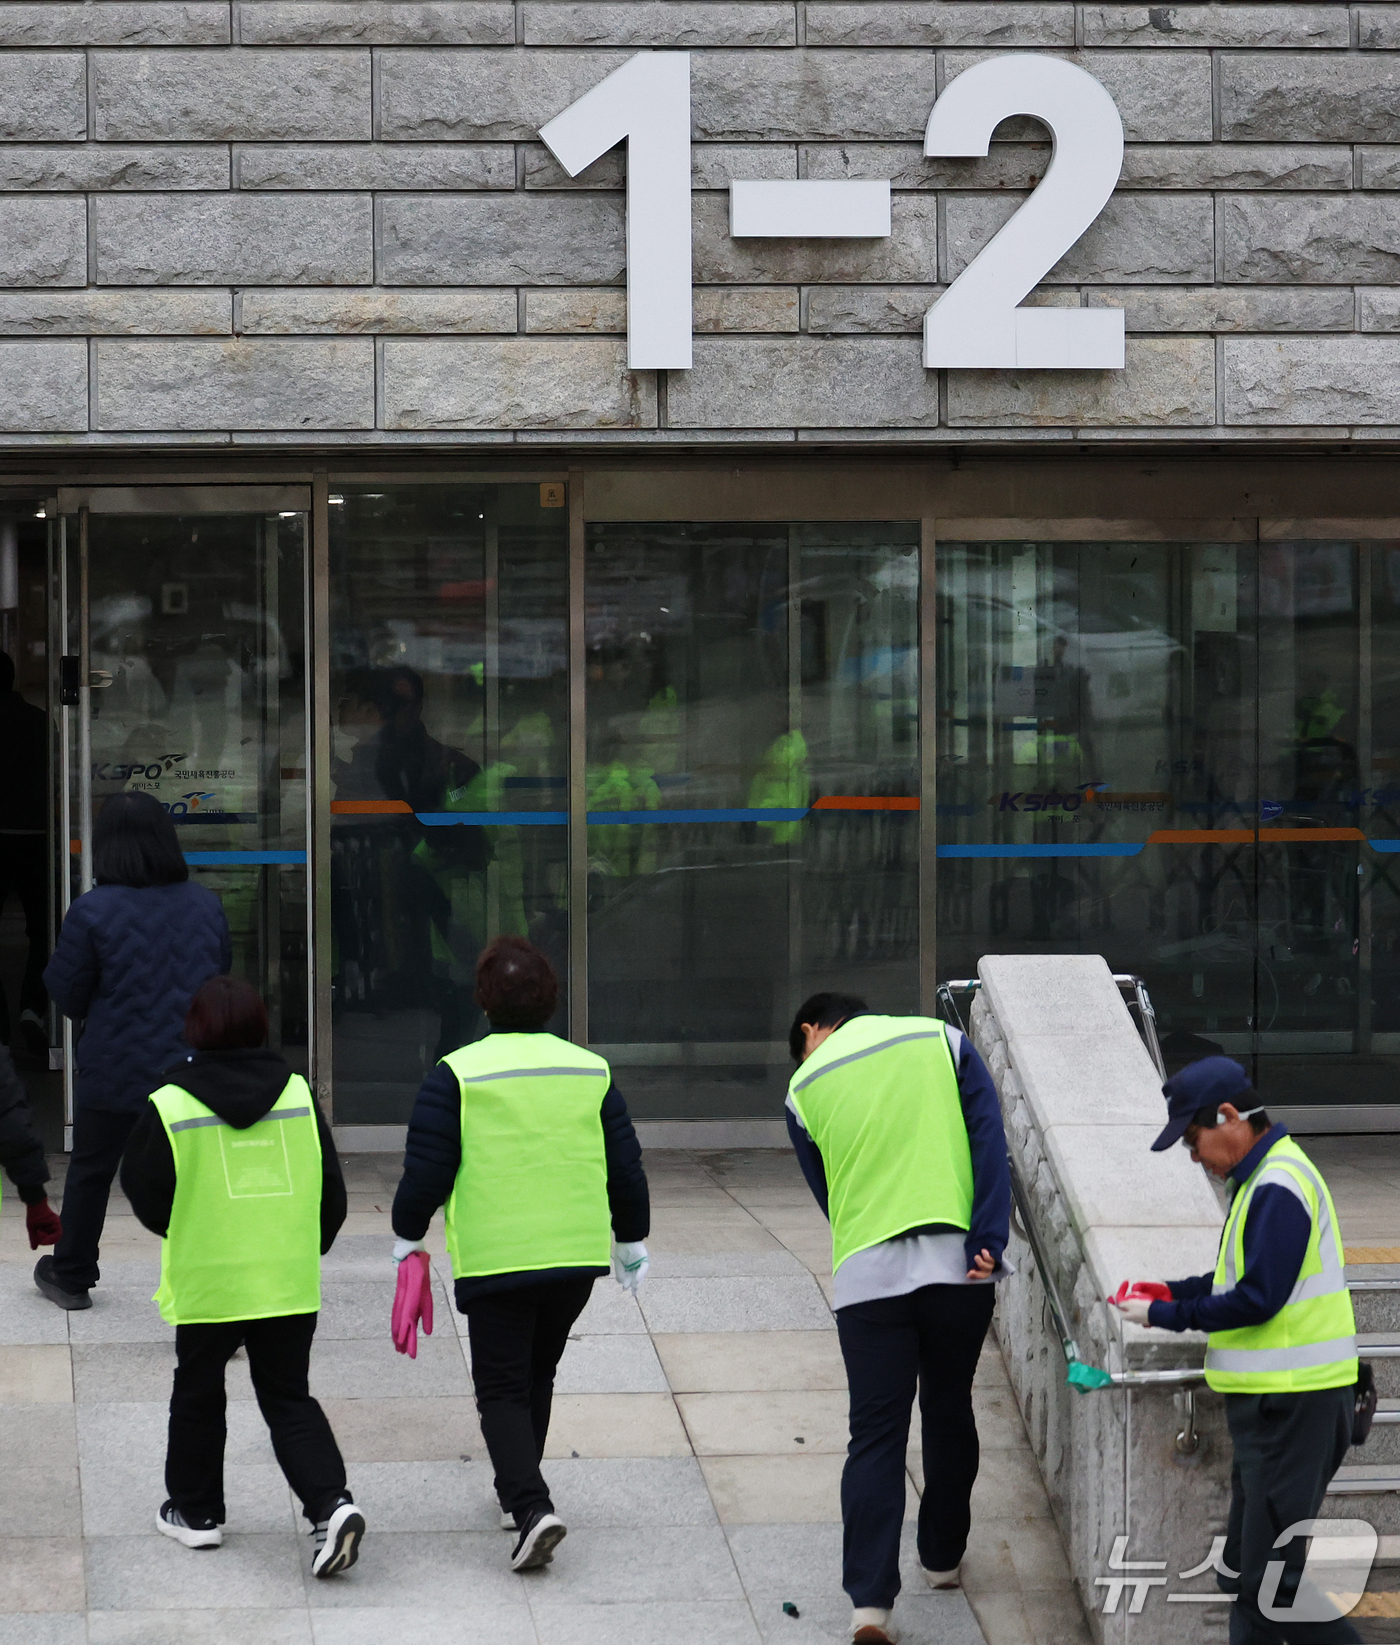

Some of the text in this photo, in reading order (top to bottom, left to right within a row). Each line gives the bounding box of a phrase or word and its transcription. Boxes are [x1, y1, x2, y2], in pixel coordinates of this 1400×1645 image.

[537, 51, 1125, 370] 1-2
[92, 763, 162, 780] KSPO
[999, 792, 1082, 811] KSPO
